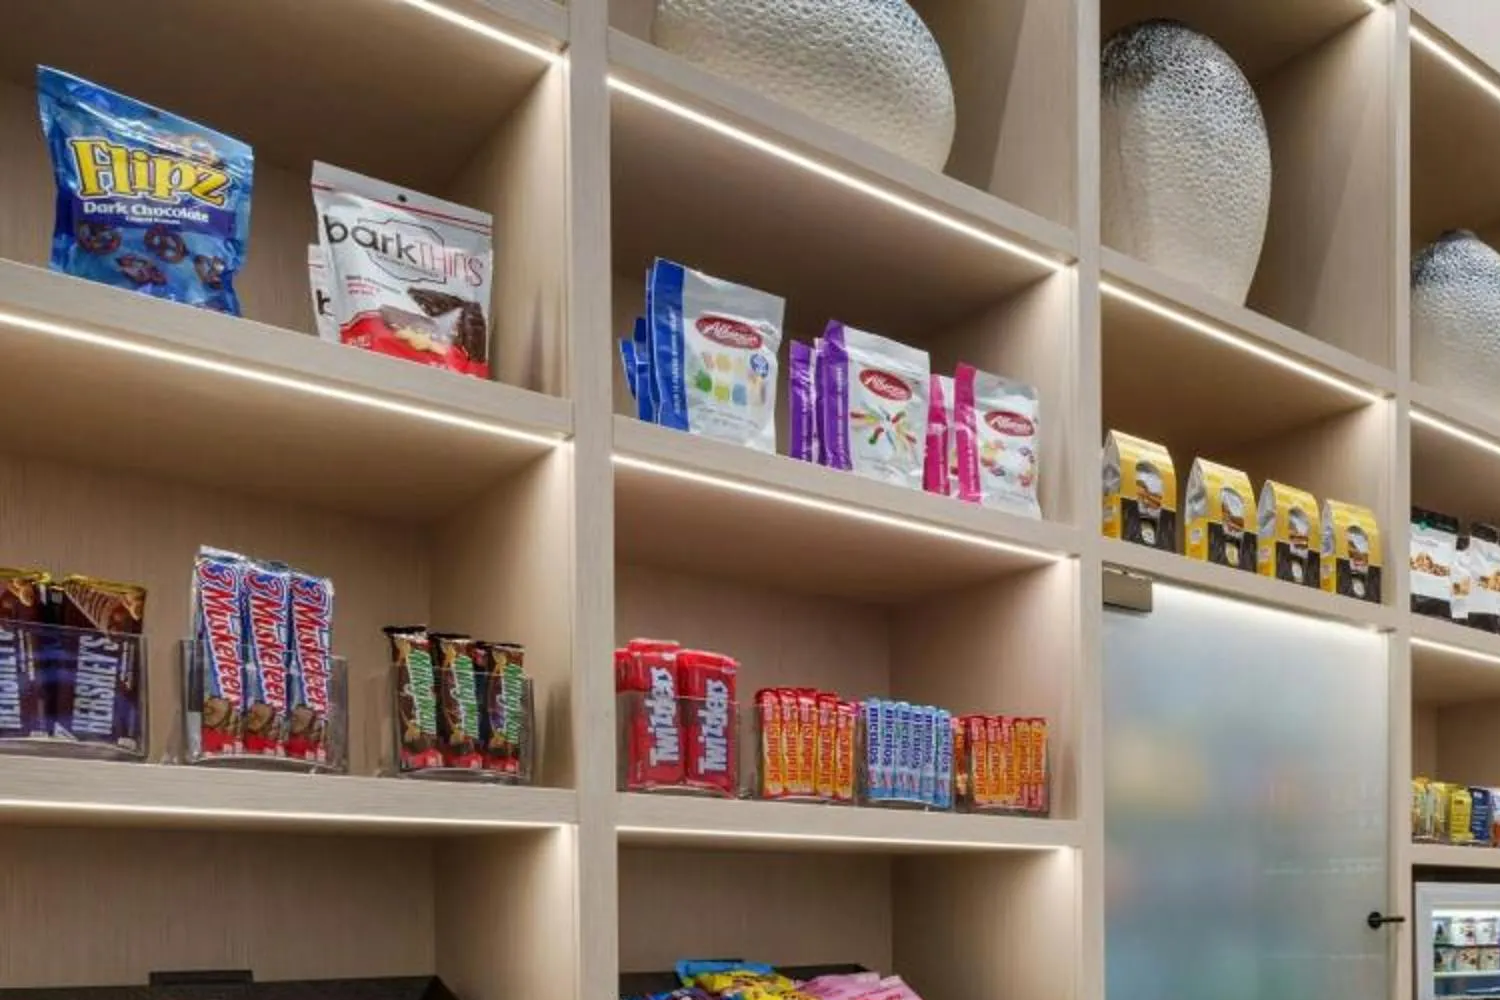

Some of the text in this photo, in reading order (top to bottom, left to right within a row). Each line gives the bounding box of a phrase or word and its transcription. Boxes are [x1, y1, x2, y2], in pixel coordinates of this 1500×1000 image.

[68, 138, 231, 206] Flipz
[83, 200, 128, 215] Dark
[131, 203, 210, 223] Chocolate
[71, 634, 119, 734] HERSHEY'S
[868, 707, 881, 766] mentos
